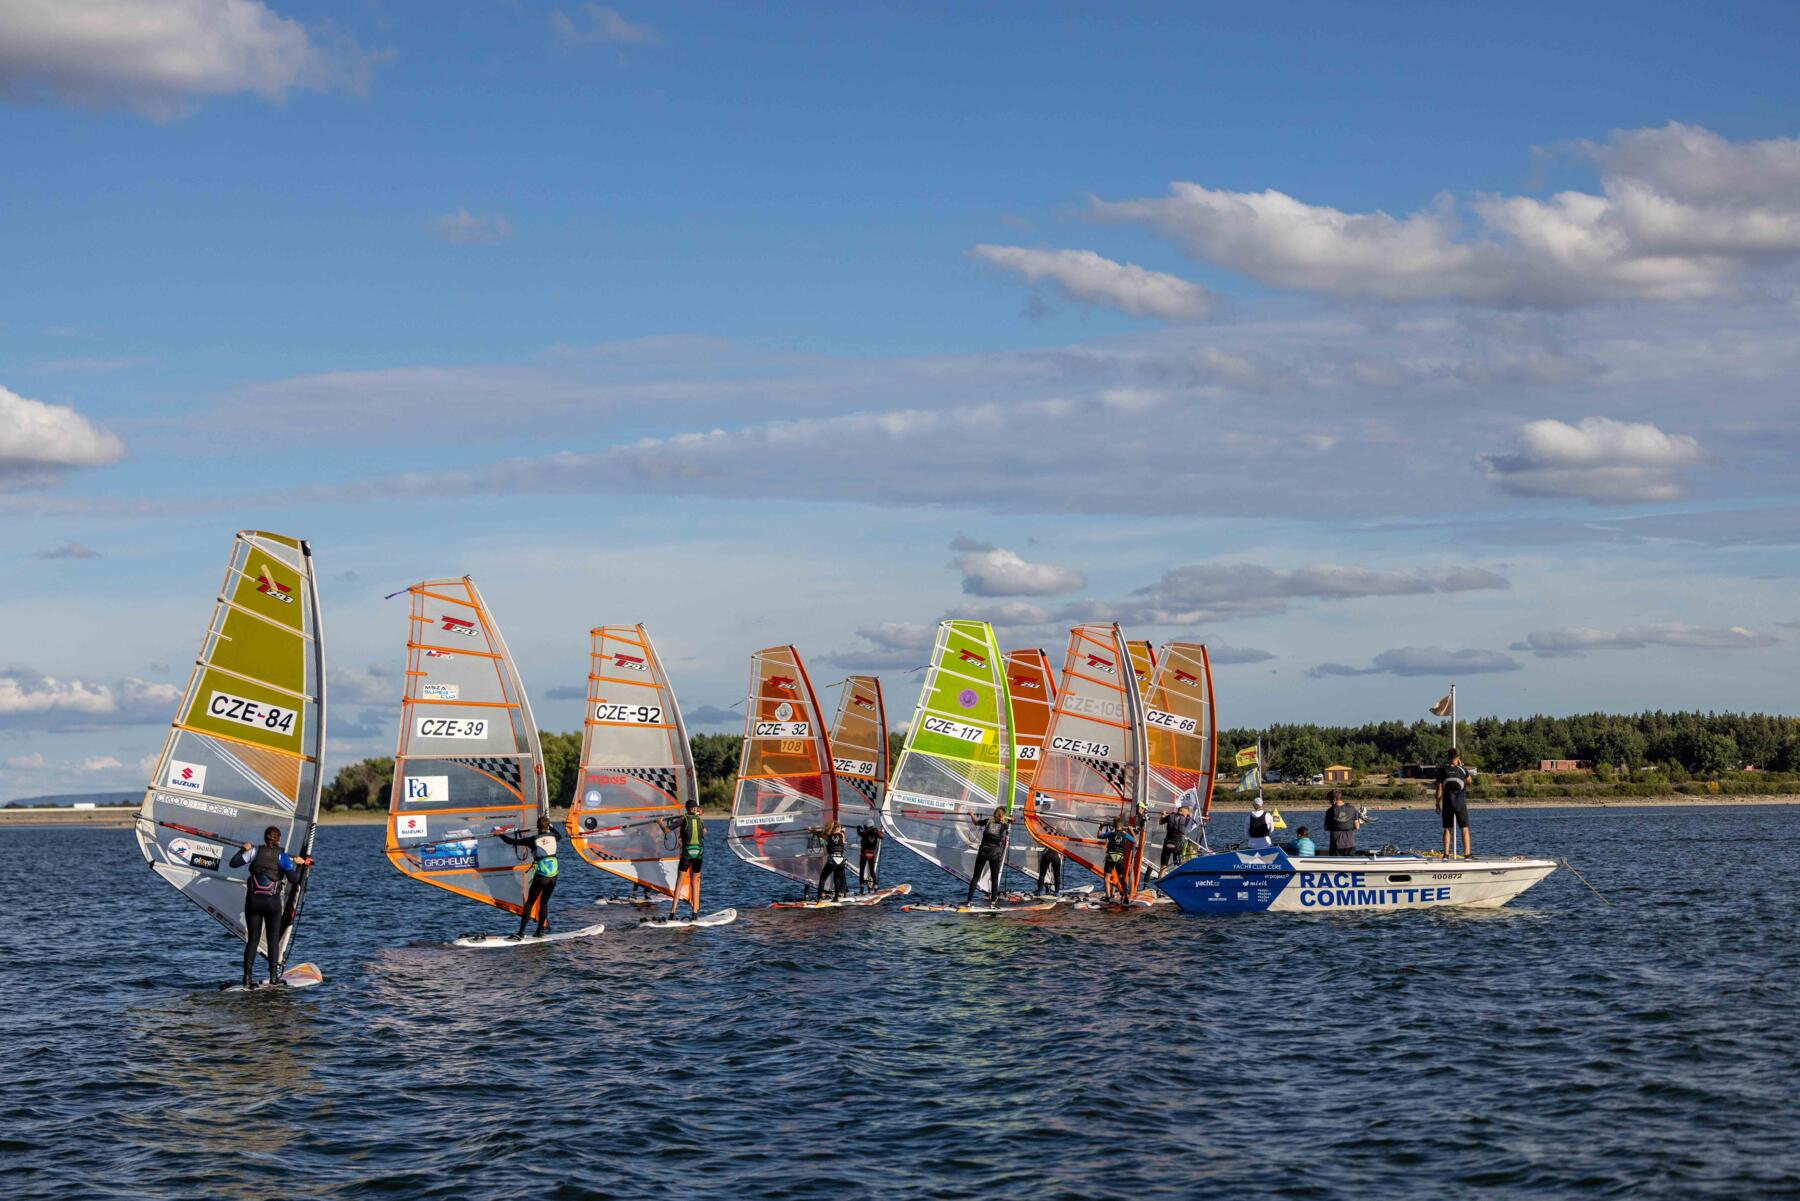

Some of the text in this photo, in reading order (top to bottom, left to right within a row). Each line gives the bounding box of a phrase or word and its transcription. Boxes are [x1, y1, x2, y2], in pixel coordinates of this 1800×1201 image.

[210, 695, 293, 732] CZE-84
[596, 704, 661, 723] CZE-92
[420, 719, 484, 736] CZE-39
[1052, 737, 1110, 757] CZE-143
[171, 778, 200, 789] SUZUKI
[408, 778, 428, 798] Fa
[1300, 872, 1366, 888] RACE
[1300, 887, 1451, 907] COMMITTEE
